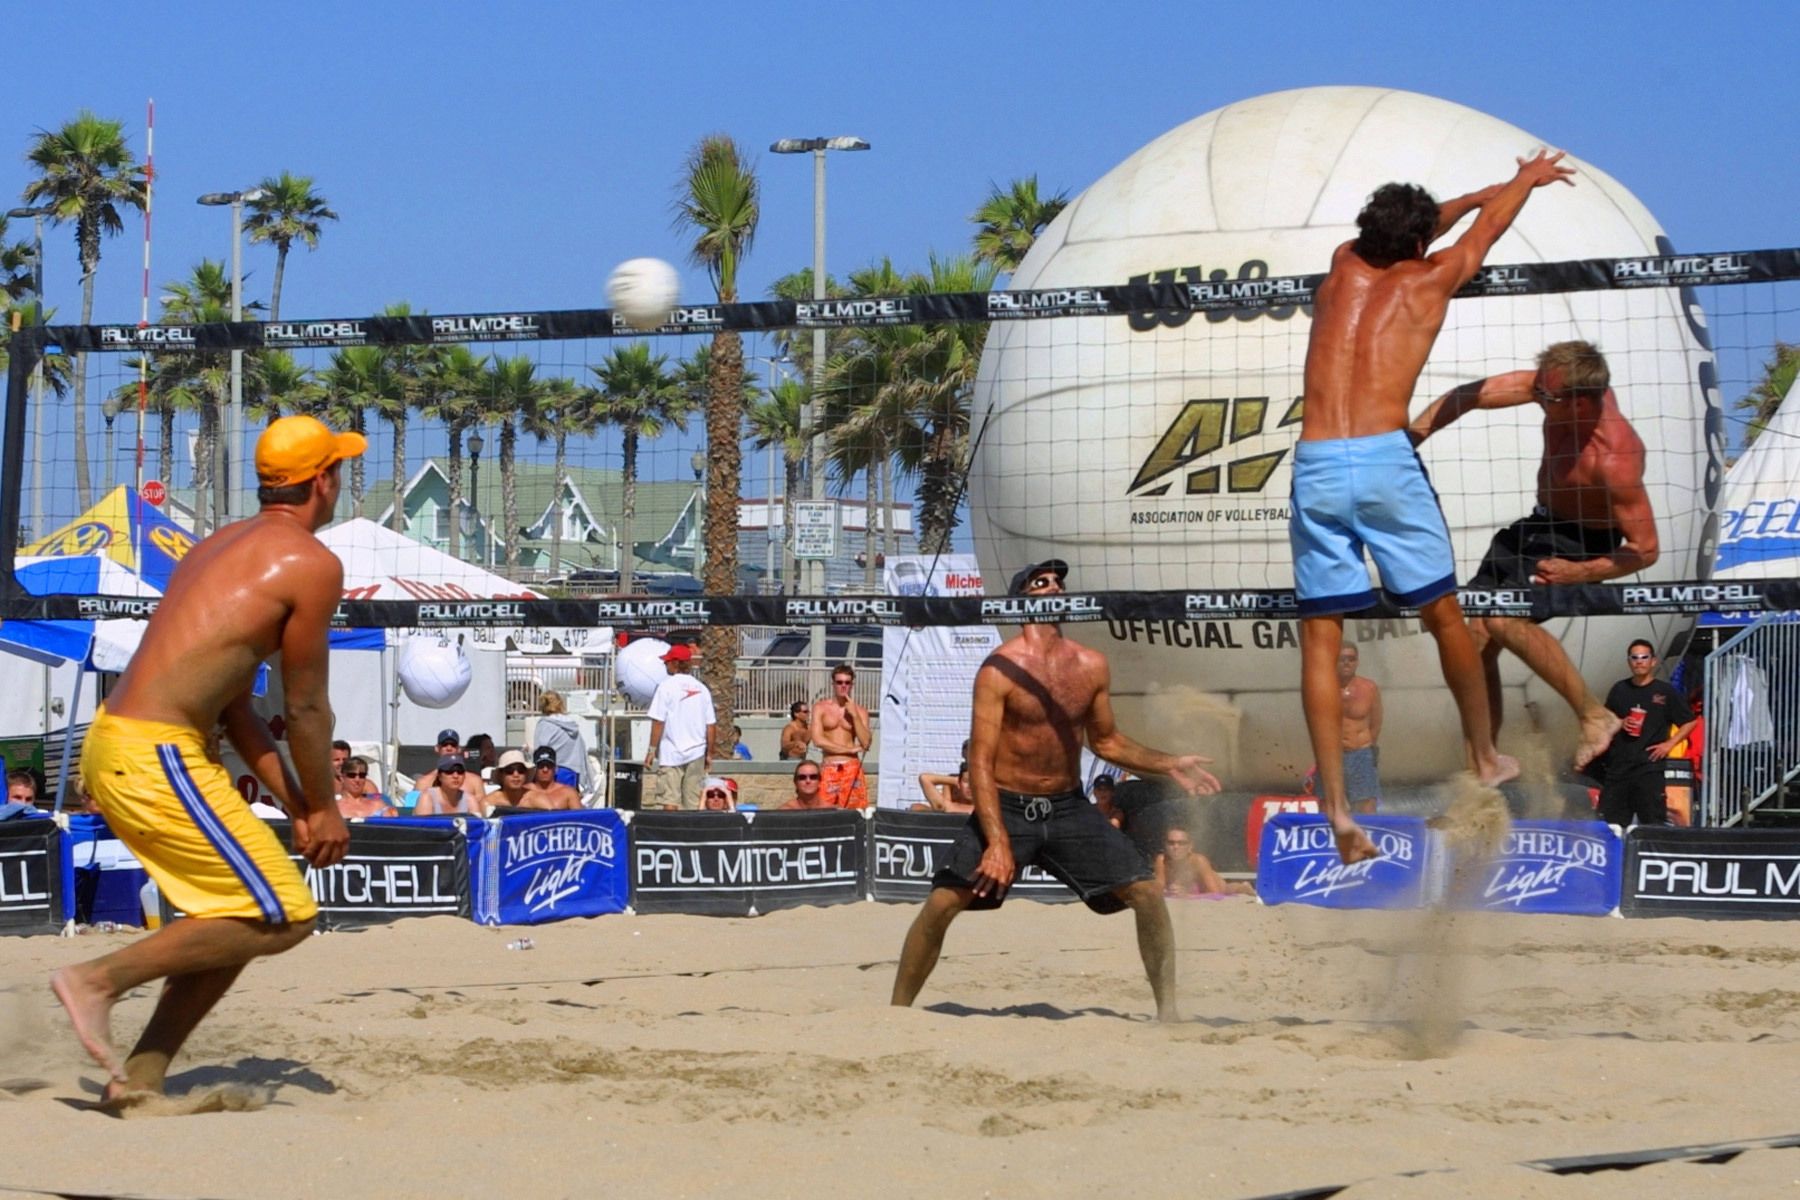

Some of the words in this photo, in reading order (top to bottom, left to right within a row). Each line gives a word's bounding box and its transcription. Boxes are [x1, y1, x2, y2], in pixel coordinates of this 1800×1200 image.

[1613, 261, 1662, 277] PAUL
[1663, 256, 1751, 274] MITCHELL
[1189, 285, 1230, 300] PAUL
[1231, 279, 1313, 297] MITCHELL
[1031, 290, 1110, 307] MITCHELL
[836, 300, 913, 316] MITCHELL
[264, 325, 299, 339] PAUL
[300, 322, 368, 337] MITCHELL
[432, 319, 469, 333] PAUL
[470, 315, 540, 331] MITCHELL
[143, 489, 165, 499] STOP
[1130, 511, 1202, 524] ASSOCIATION
[1206, 510, 1223, 522] OF
[1226, 508, 1291, 521] VOLLEYBAL
[1186, 594, 1229, 609] PAUL
[1230, 593, 1299, 609] MITCHEL
[1622, 587, 1671, 602] PAUL
[1671, 585, 1764, 601] MITCHELL
[110, 601, 160, 614] MITCHE
[418, 604, 455, 617] PAUL
[456, 604, 527, 617] MITCHELL
[598, 603, 636, 617] PAUL
[637, 602, 712, 616] MITCHELL
[786, 601, 826, 615] PAUL
[827, 600, 904, 615] MITCHELL
[981, 600, 1023, 614] PAUL
[1024, 597, 1103, 613] MITCHELL
[473, 627, 496, 644] ball
[530, 627, 550, 645] the
[563, 629, 588, 647] AVP
[1109, 620, 1242, 648] OFFICIAL
[504, 825, 614, 868] MICHELOB
[637, 849, 714, 884] PAUL
[718, 845, 857, 884] MITCHELL
[524, 853, 594, 912] Light
[1638, 859, 1757, 894] PAUL
